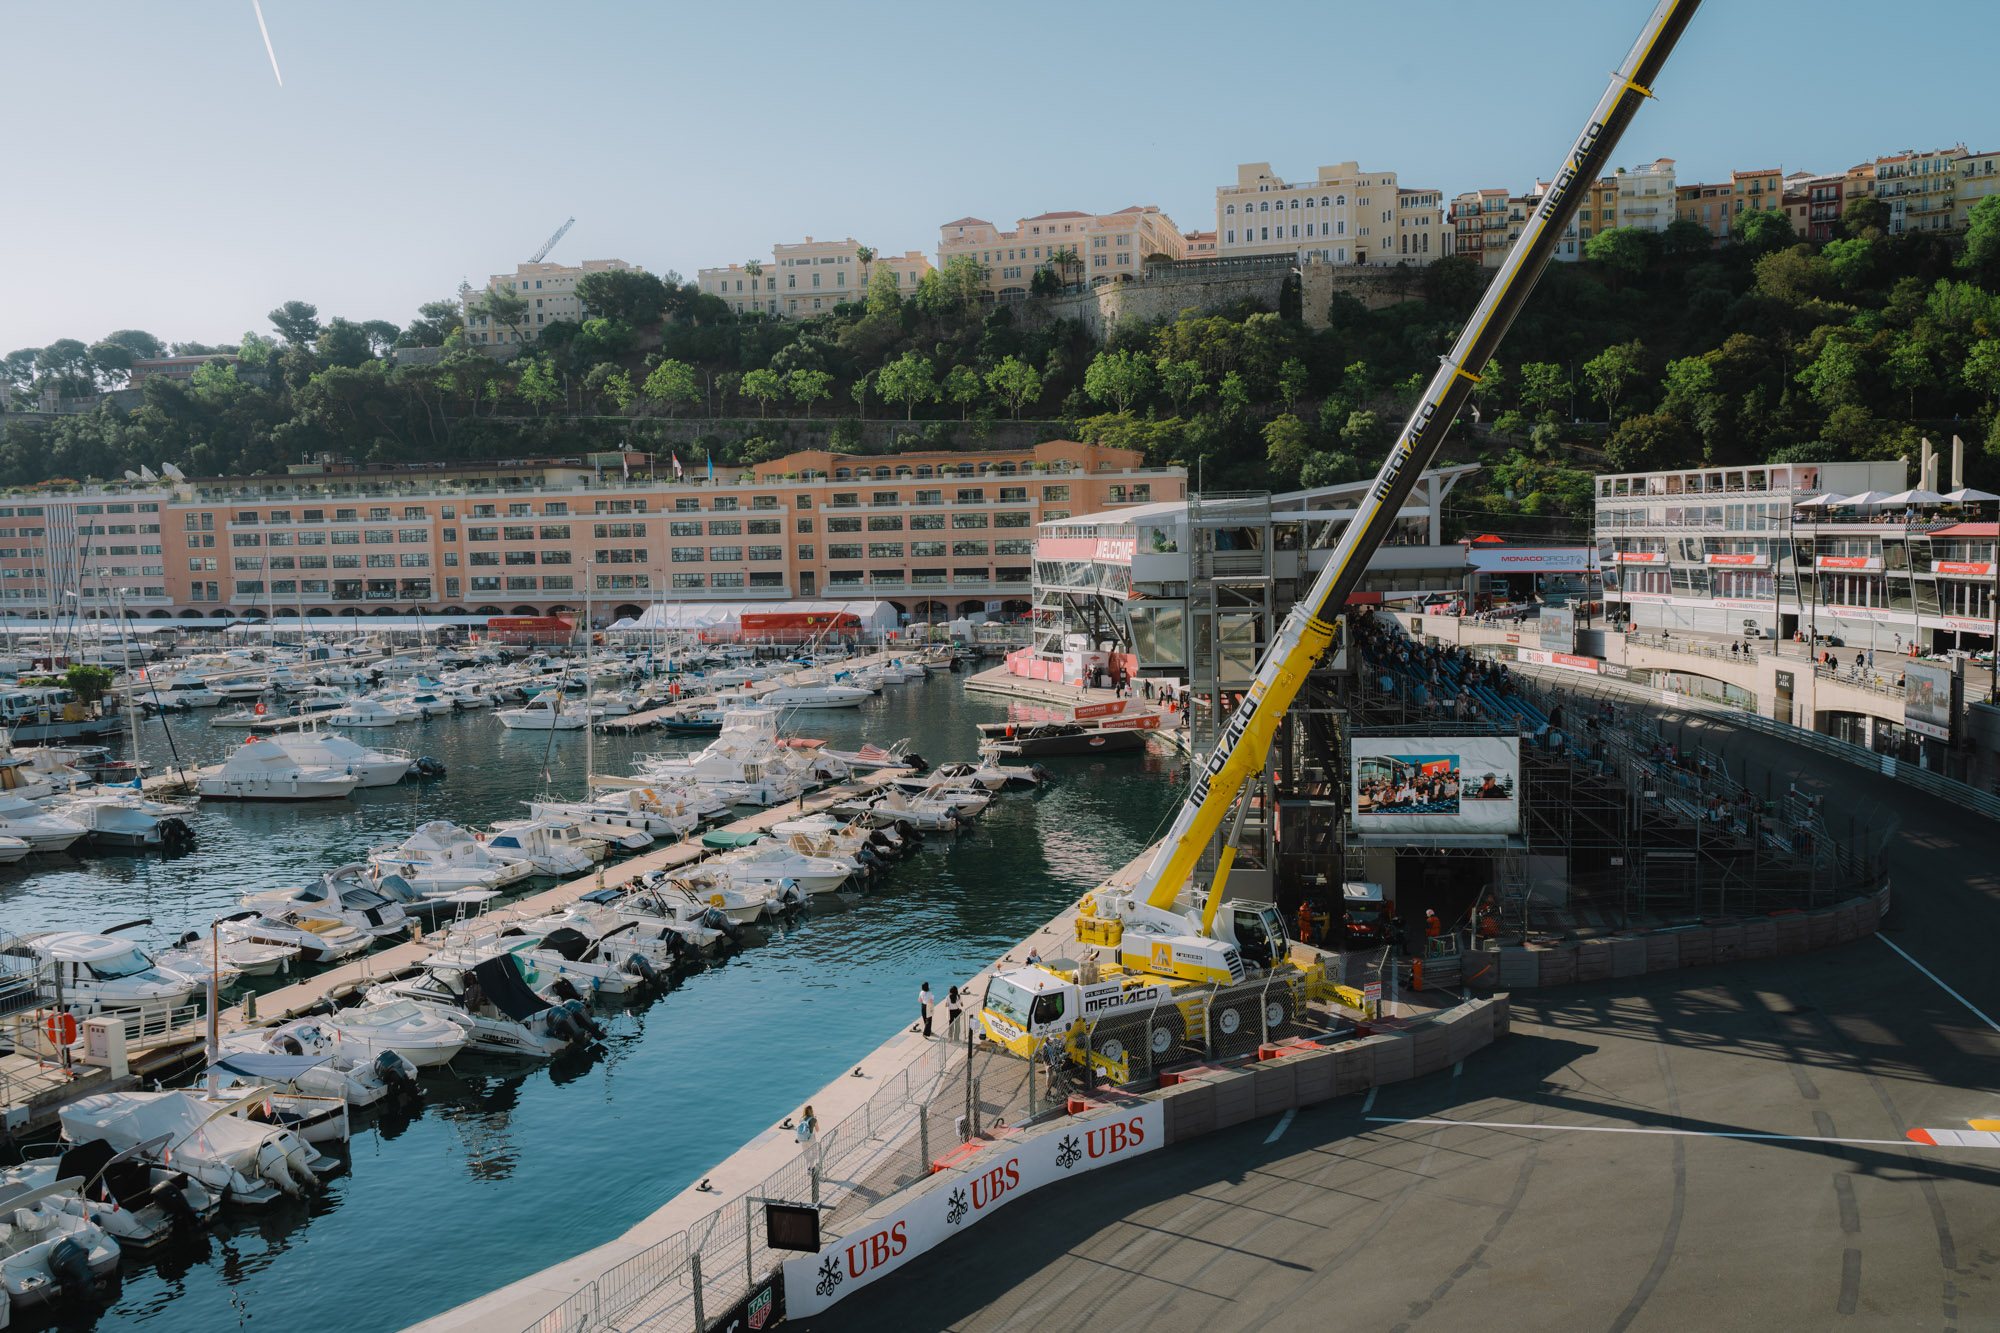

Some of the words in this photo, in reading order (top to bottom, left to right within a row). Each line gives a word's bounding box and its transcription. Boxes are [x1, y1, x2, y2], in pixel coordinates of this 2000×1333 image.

[1096, 540, 1134, 560] WELCOME
[1532, 652, 1545, 663] UBS
[482, 1034, 519, 1044] HYDRA-SPORTS
[1085, 1117, 1145, 1159] UBS
[969, 1158, 1020, 1210] UBS
[845, 1220, 907, 1279] UBS
[749, 1291, 770, 1313] TAG
[748, 1303, 771, 1328] HEUER
